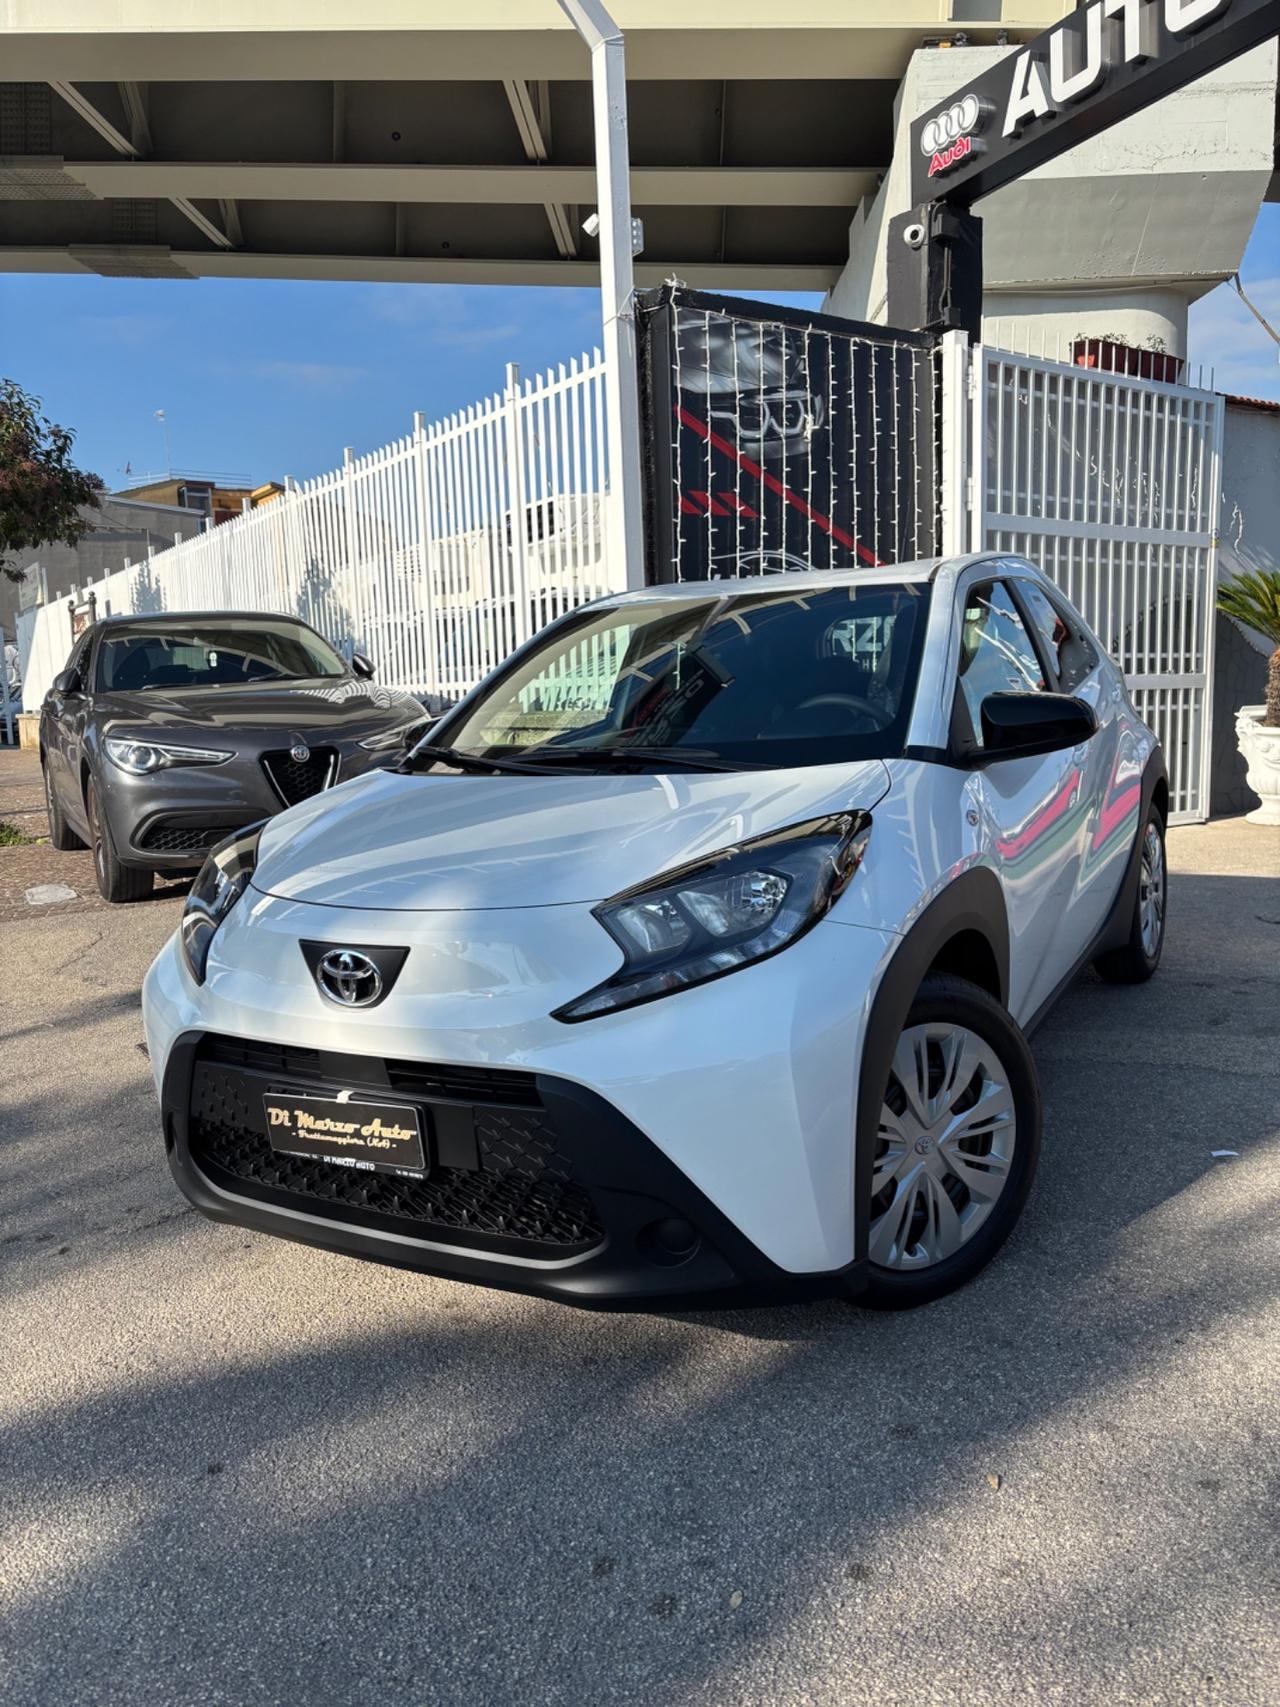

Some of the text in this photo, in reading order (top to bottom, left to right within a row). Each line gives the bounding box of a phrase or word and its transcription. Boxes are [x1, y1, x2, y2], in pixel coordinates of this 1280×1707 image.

[928, 136, 971, 178] Audi
[267, 1107, 417, 1141] Di Marzo Auto
